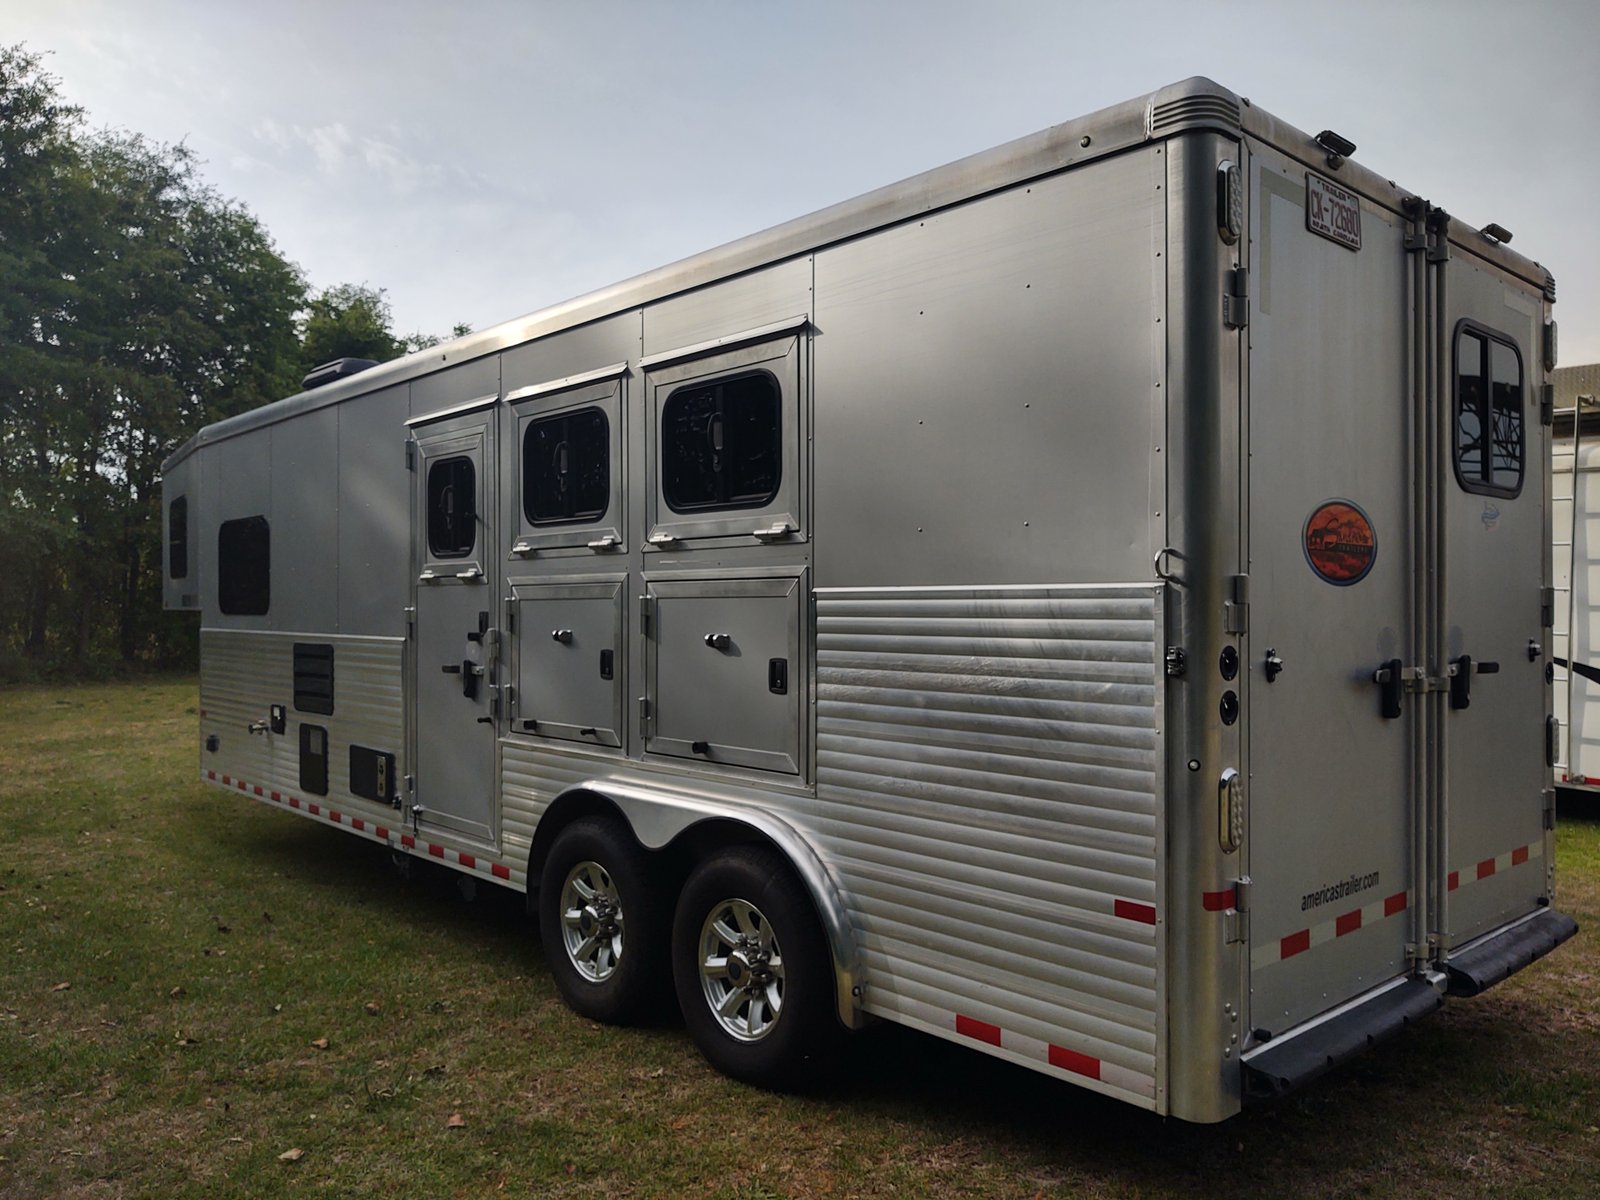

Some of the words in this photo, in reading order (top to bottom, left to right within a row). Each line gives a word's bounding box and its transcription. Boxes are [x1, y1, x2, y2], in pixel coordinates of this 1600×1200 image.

[1322, 182, 1347, 201] TRAILER
[1311, 189, 1359, 237] CK-72680
[1312, 219, 1331, 233] NORTH
[1333, 229, 1359, 246] CAROLINA
[1301, 871, 1379, 911] americastrailer.com
